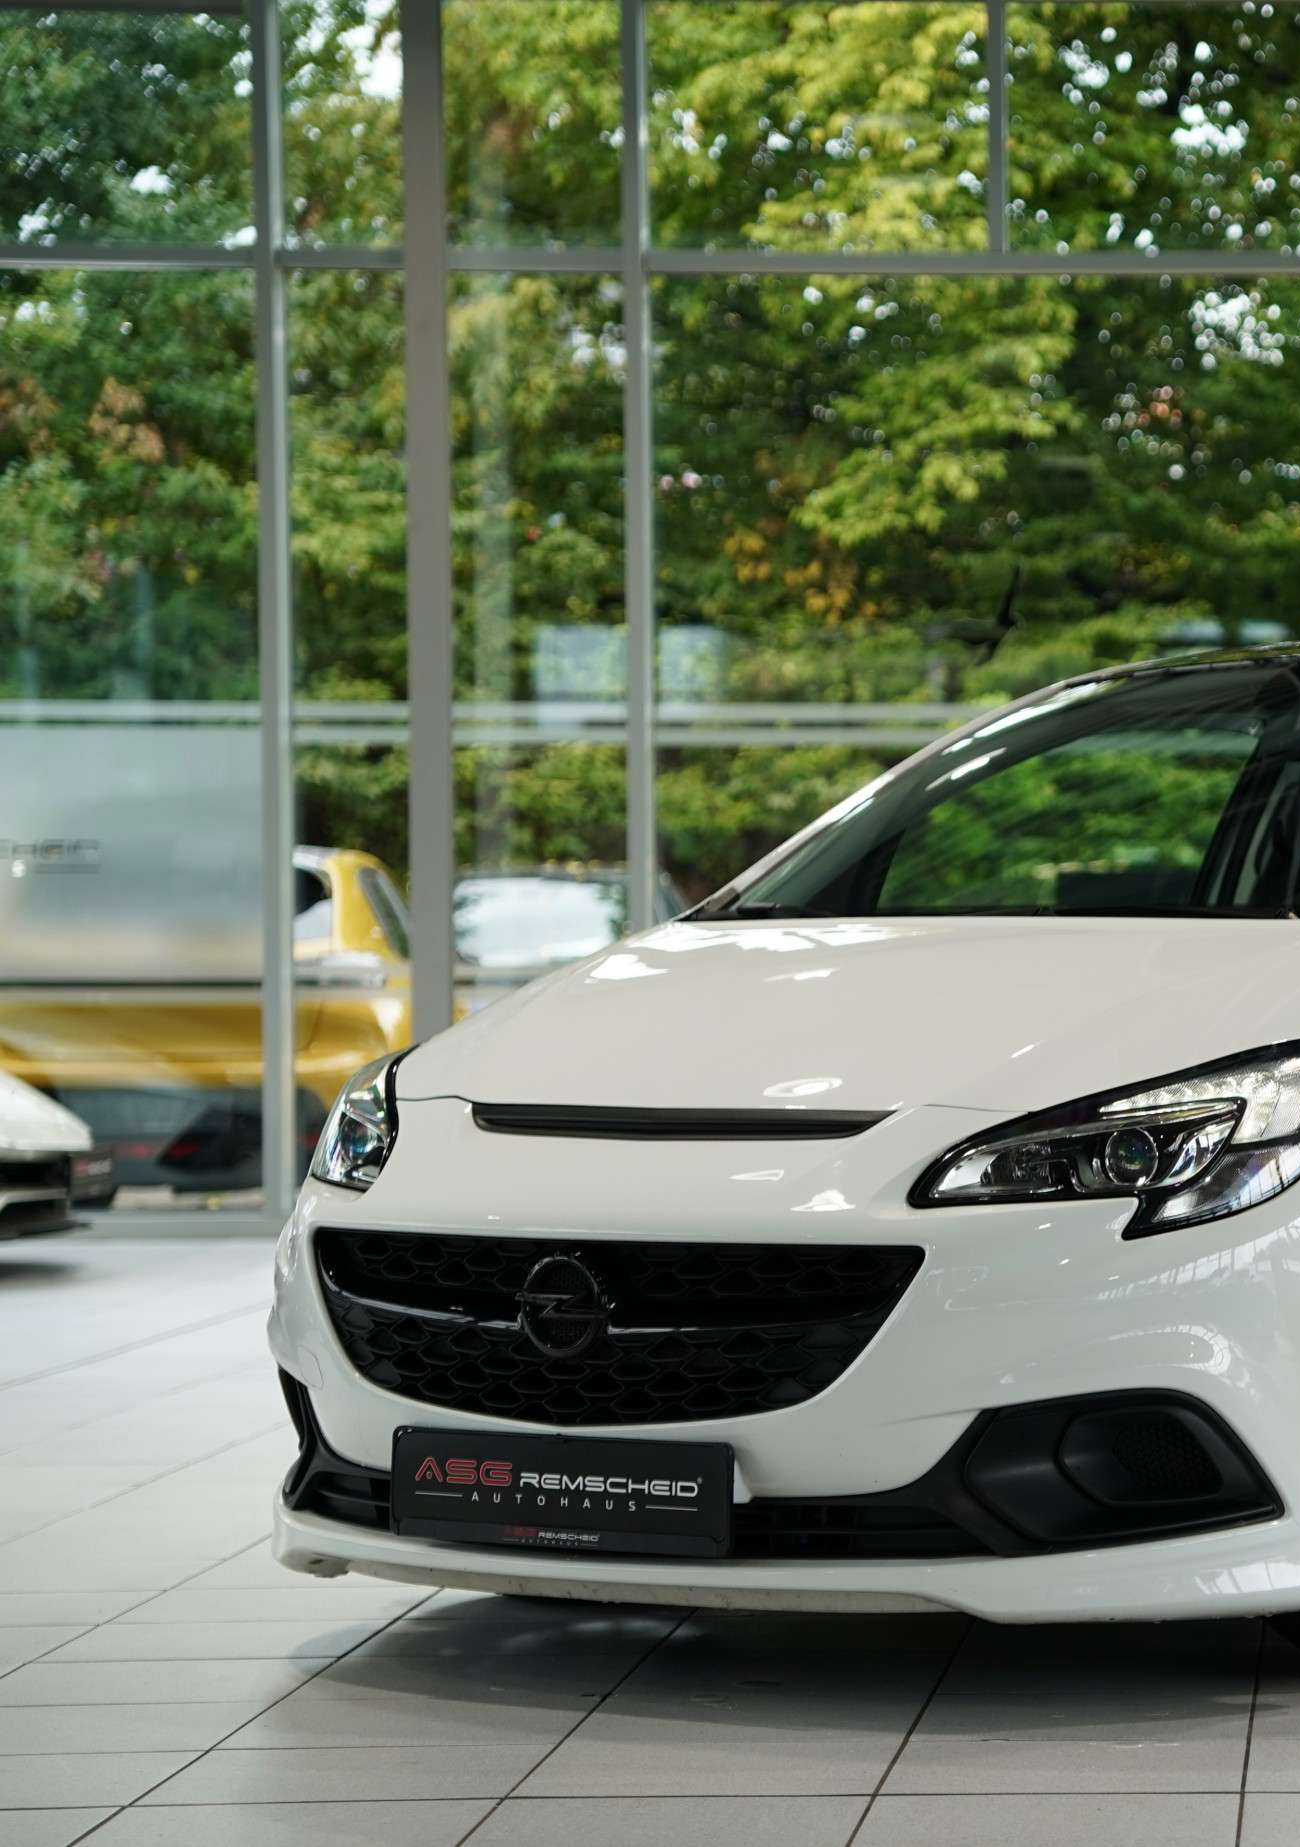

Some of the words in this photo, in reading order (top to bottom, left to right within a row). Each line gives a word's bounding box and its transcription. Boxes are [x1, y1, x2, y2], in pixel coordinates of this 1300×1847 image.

[415, 1456, 513, 1486] ASG
[519, 1472, 699, 1498] REMSCHEID
[471, 1491, 637, 1512] AUTOHAUS
